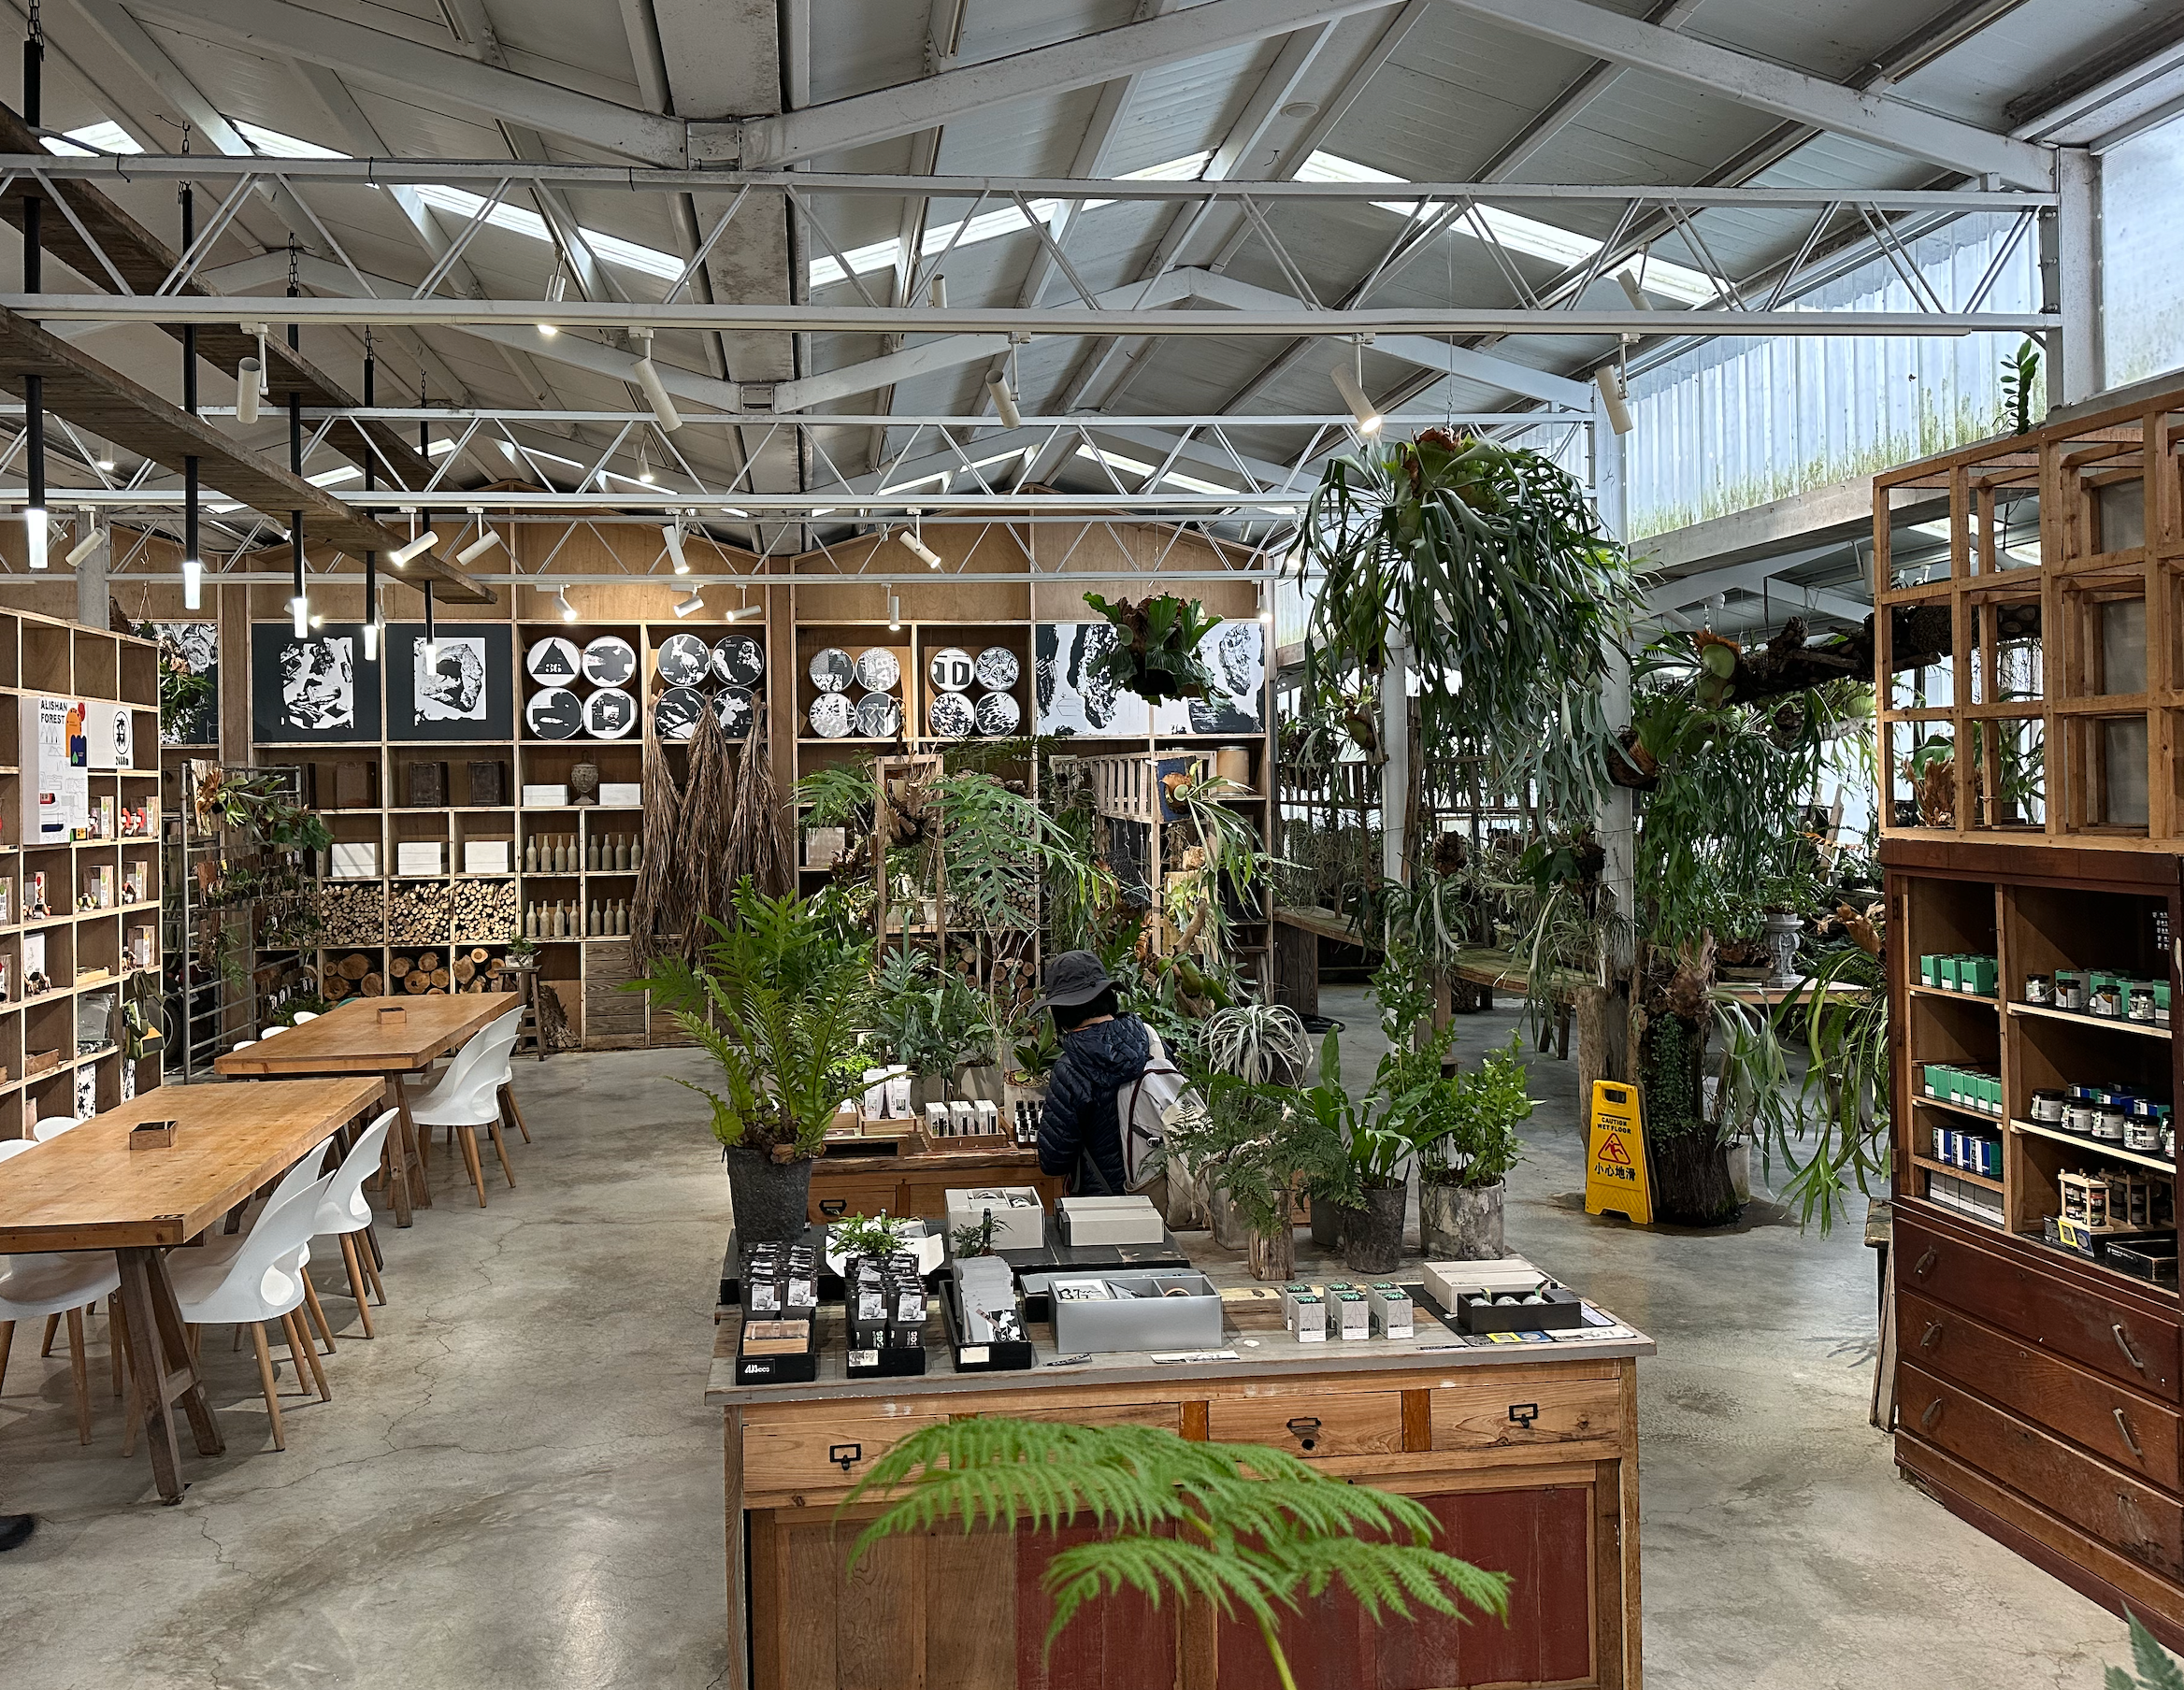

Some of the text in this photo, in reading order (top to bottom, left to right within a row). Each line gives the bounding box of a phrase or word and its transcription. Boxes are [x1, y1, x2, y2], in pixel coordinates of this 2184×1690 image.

[545, 663, 563, 673] 36
[40, 699, 68, 711] ALISHAN
[40, 712, 65, 724] FOREST
[1602, 1117, 1627, 1126] CAUTION
[1611, 1125, 1631, 1134] FLOOR
[1594, 1162, 1636, 1182] 小心地滑
